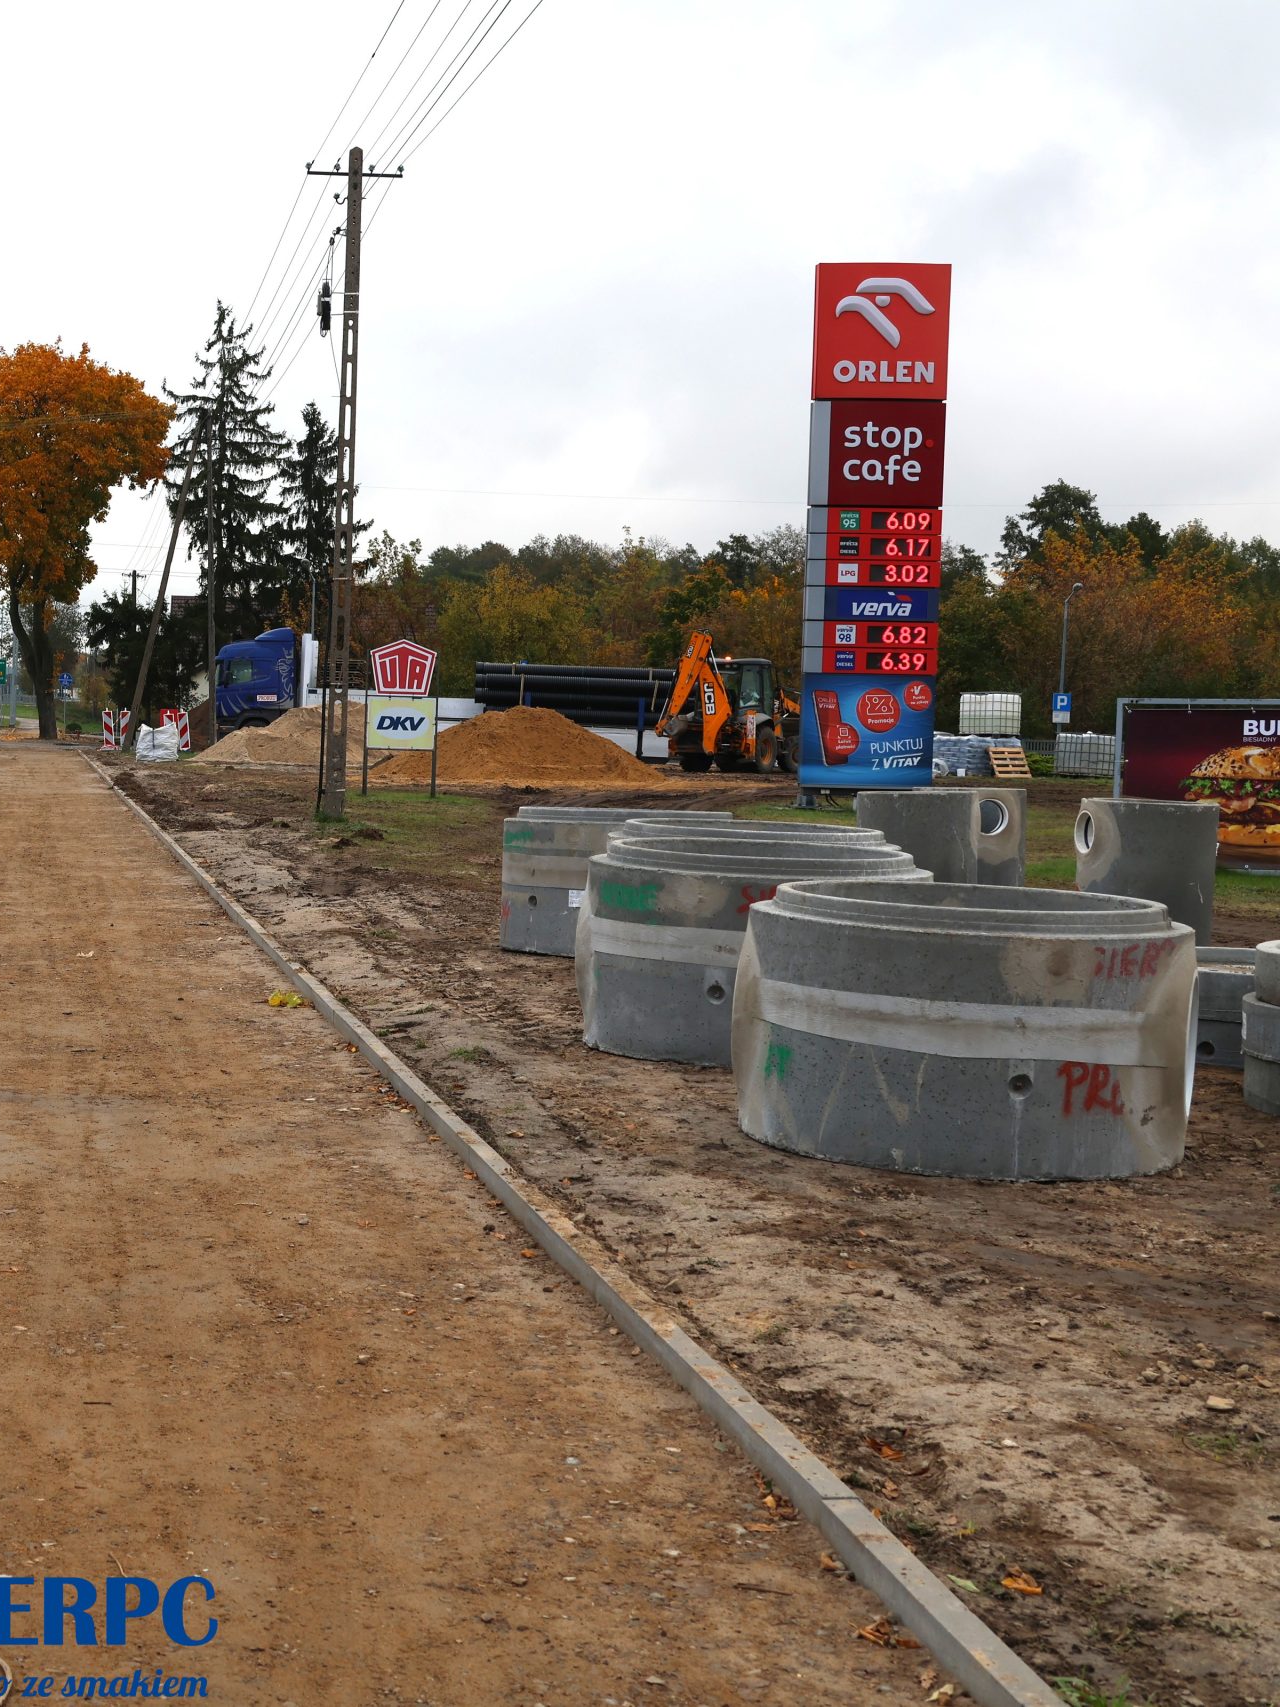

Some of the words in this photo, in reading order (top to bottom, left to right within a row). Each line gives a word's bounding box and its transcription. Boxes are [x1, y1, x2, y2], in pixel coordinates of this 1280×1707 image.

[833, 360, 935, 383] ORLEN
[842, 454, 922, 485] cafe
[842, 518, 856, 528] 95
[886, 512, 931, 530] 6.09
[885, 538, 929, 557] 6.17
[884, 564, 929, 583] 3.02
[852, 602, 912, 616] verva
[838, 633, 852, 642] 98
[882, 626, 926, 644] 6.82
[378, 646, 429, 690] UTA
[881, 652, 926, 670] 6.39
[703, 683, 716, 715] JCB
[1056, 695, 1068, 709] P
[376, 715, 426, 731] DKV
[1243, 719, 1280, 736] BU
[870, 738, 923, 754] PUNKTUJ
